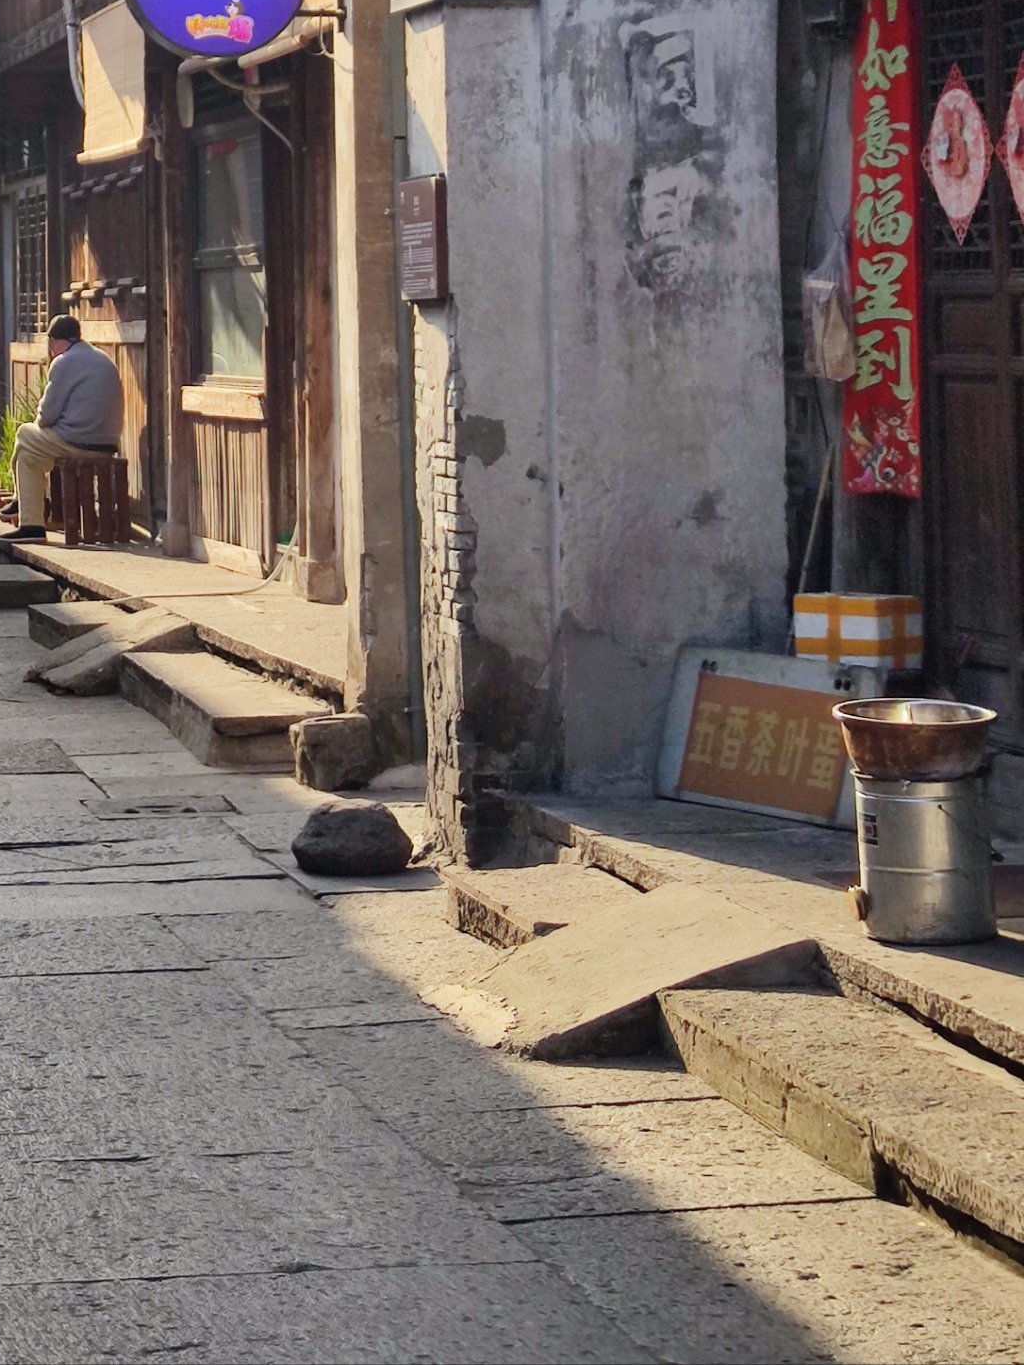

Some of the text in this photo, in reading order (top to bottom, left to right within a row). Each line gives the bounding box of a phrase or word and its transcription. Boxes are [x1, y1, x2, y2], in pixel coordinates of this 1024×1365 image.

[688, 701, 841, 791] 五香茶叶蛋
